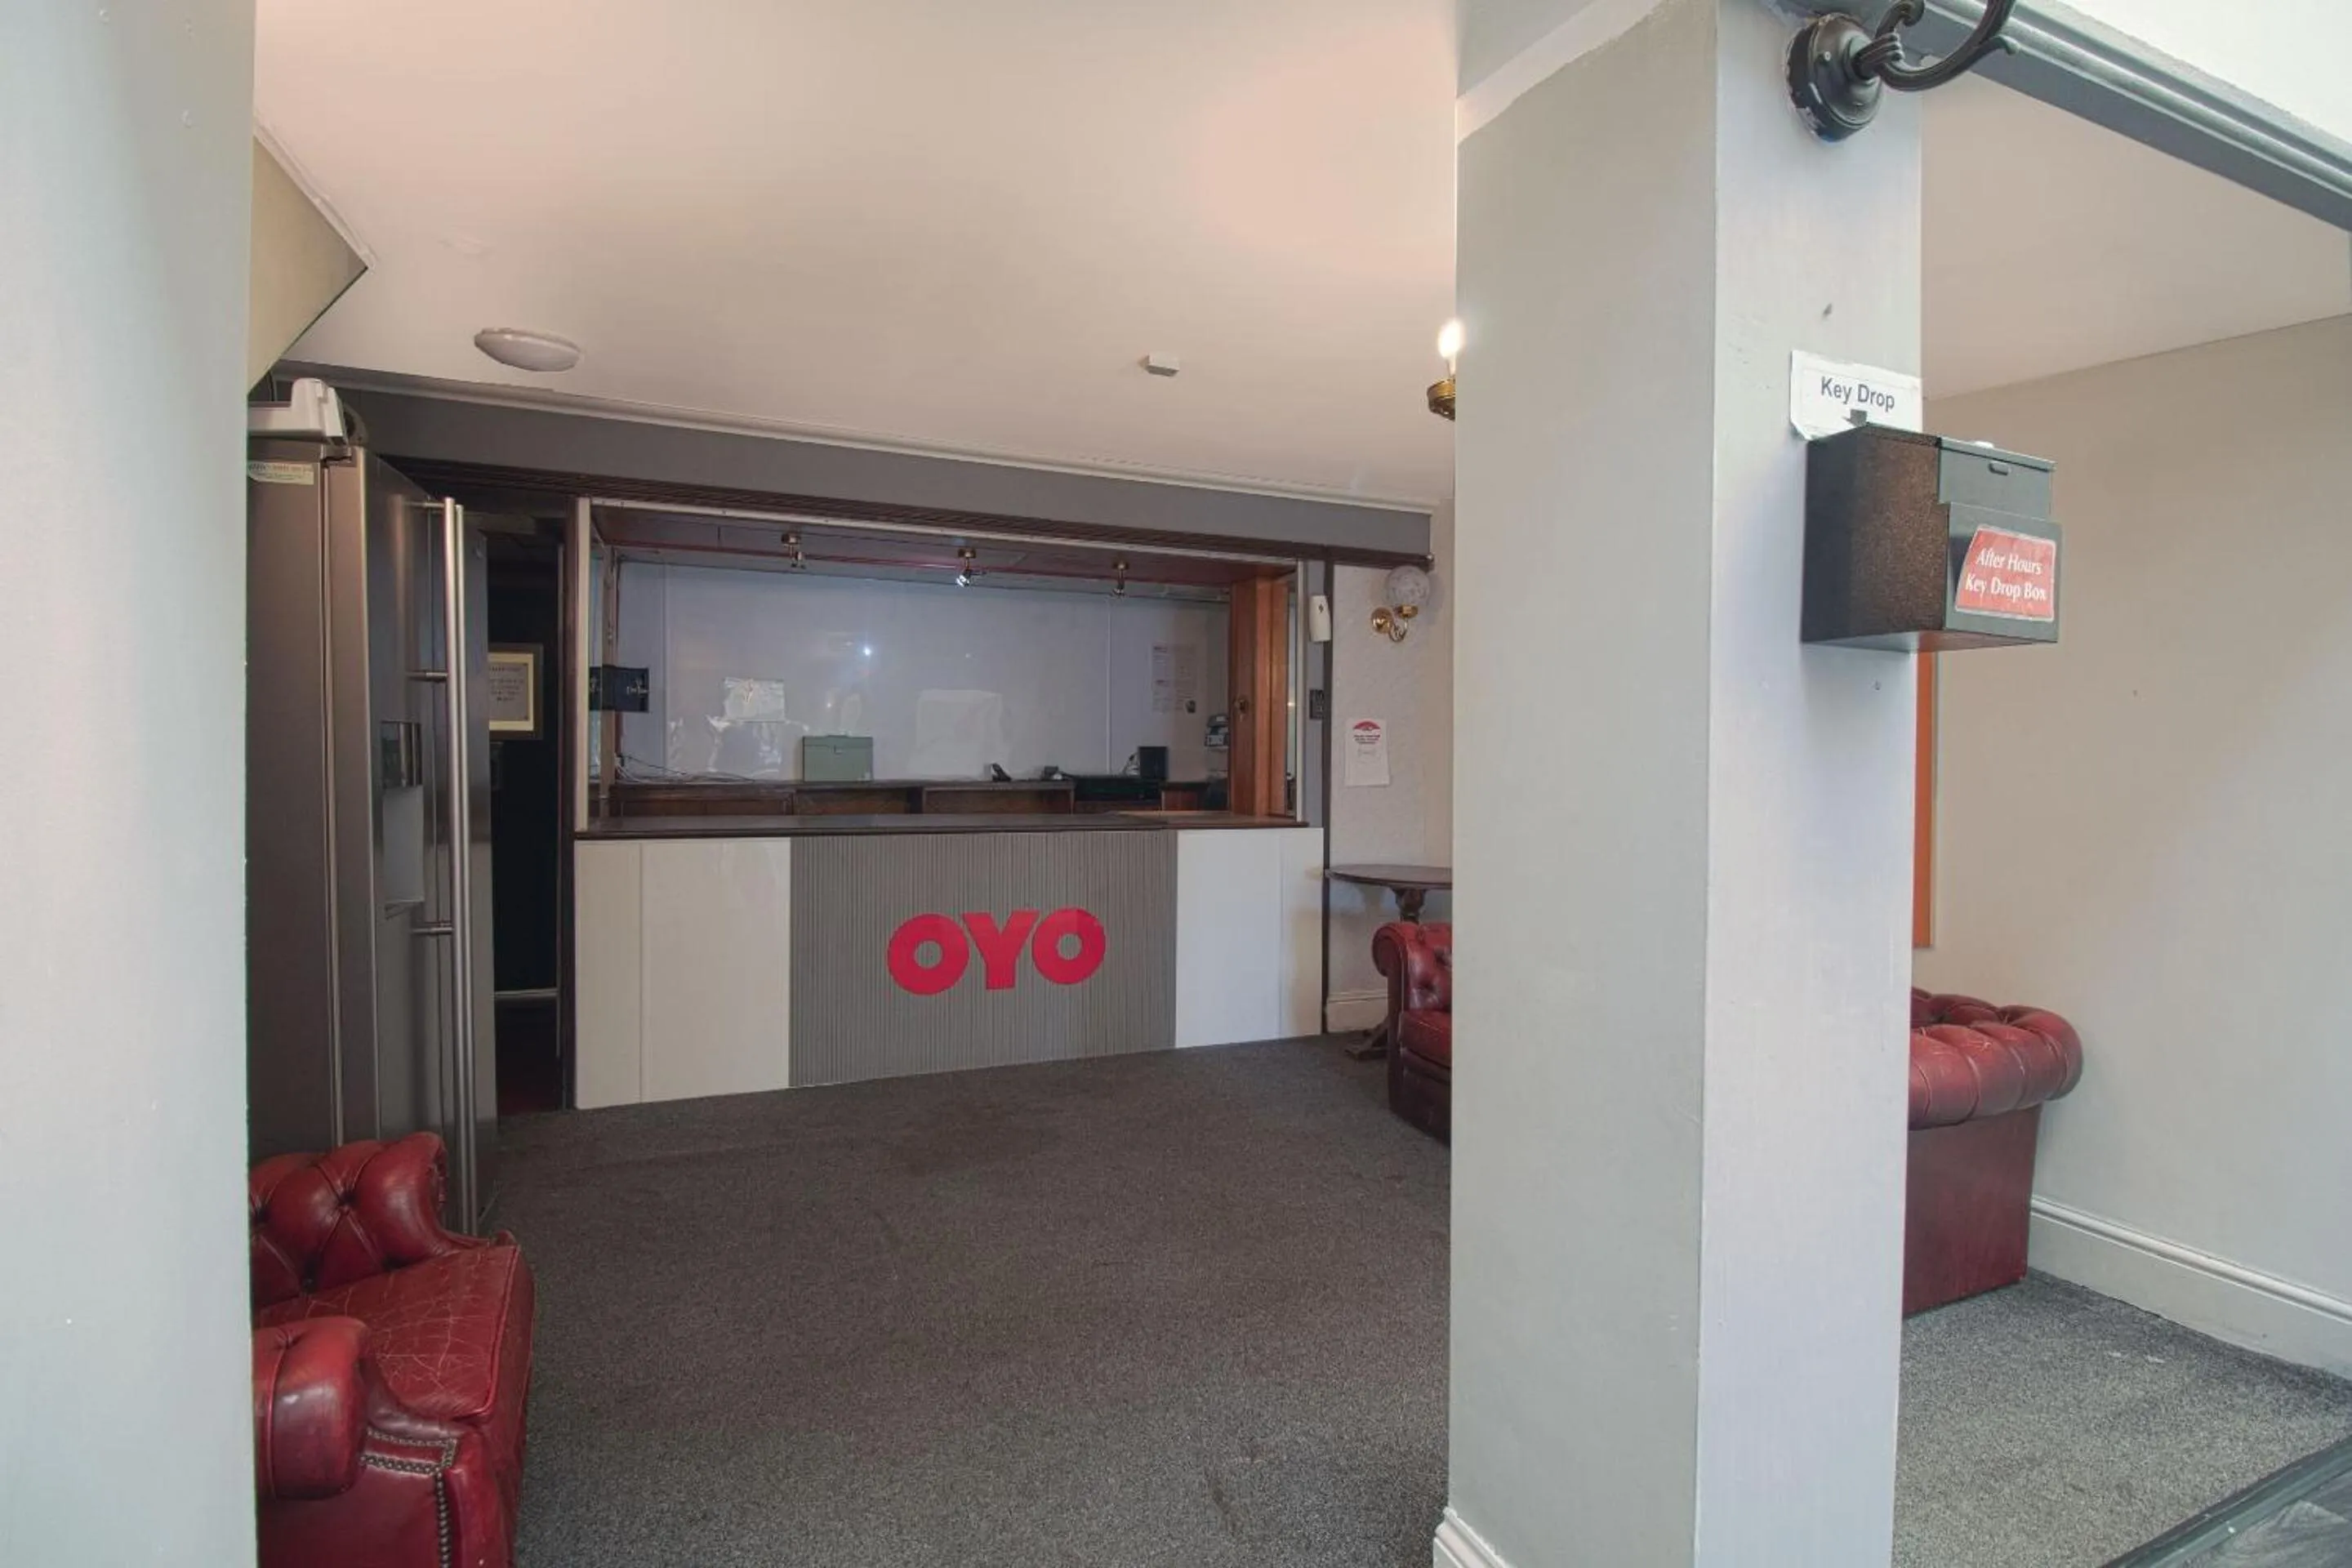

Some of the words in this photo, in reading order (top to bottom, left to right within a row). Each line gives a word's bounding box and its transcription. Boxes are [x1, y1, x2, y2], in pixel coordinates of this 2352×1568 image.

[1821, 376, 1852, 405] Key
[1857, 384, 1895, 412] Drop
[1976, 548, 2006, 568] After
[2008, 554, 2042, 575] Hours
[1966, 573, 1987, 599] Key
[1991, 577, 2021, 604] Drop
[2025, 581, 2047, 601] Box
[887, 907, 1106, 996] OYO
